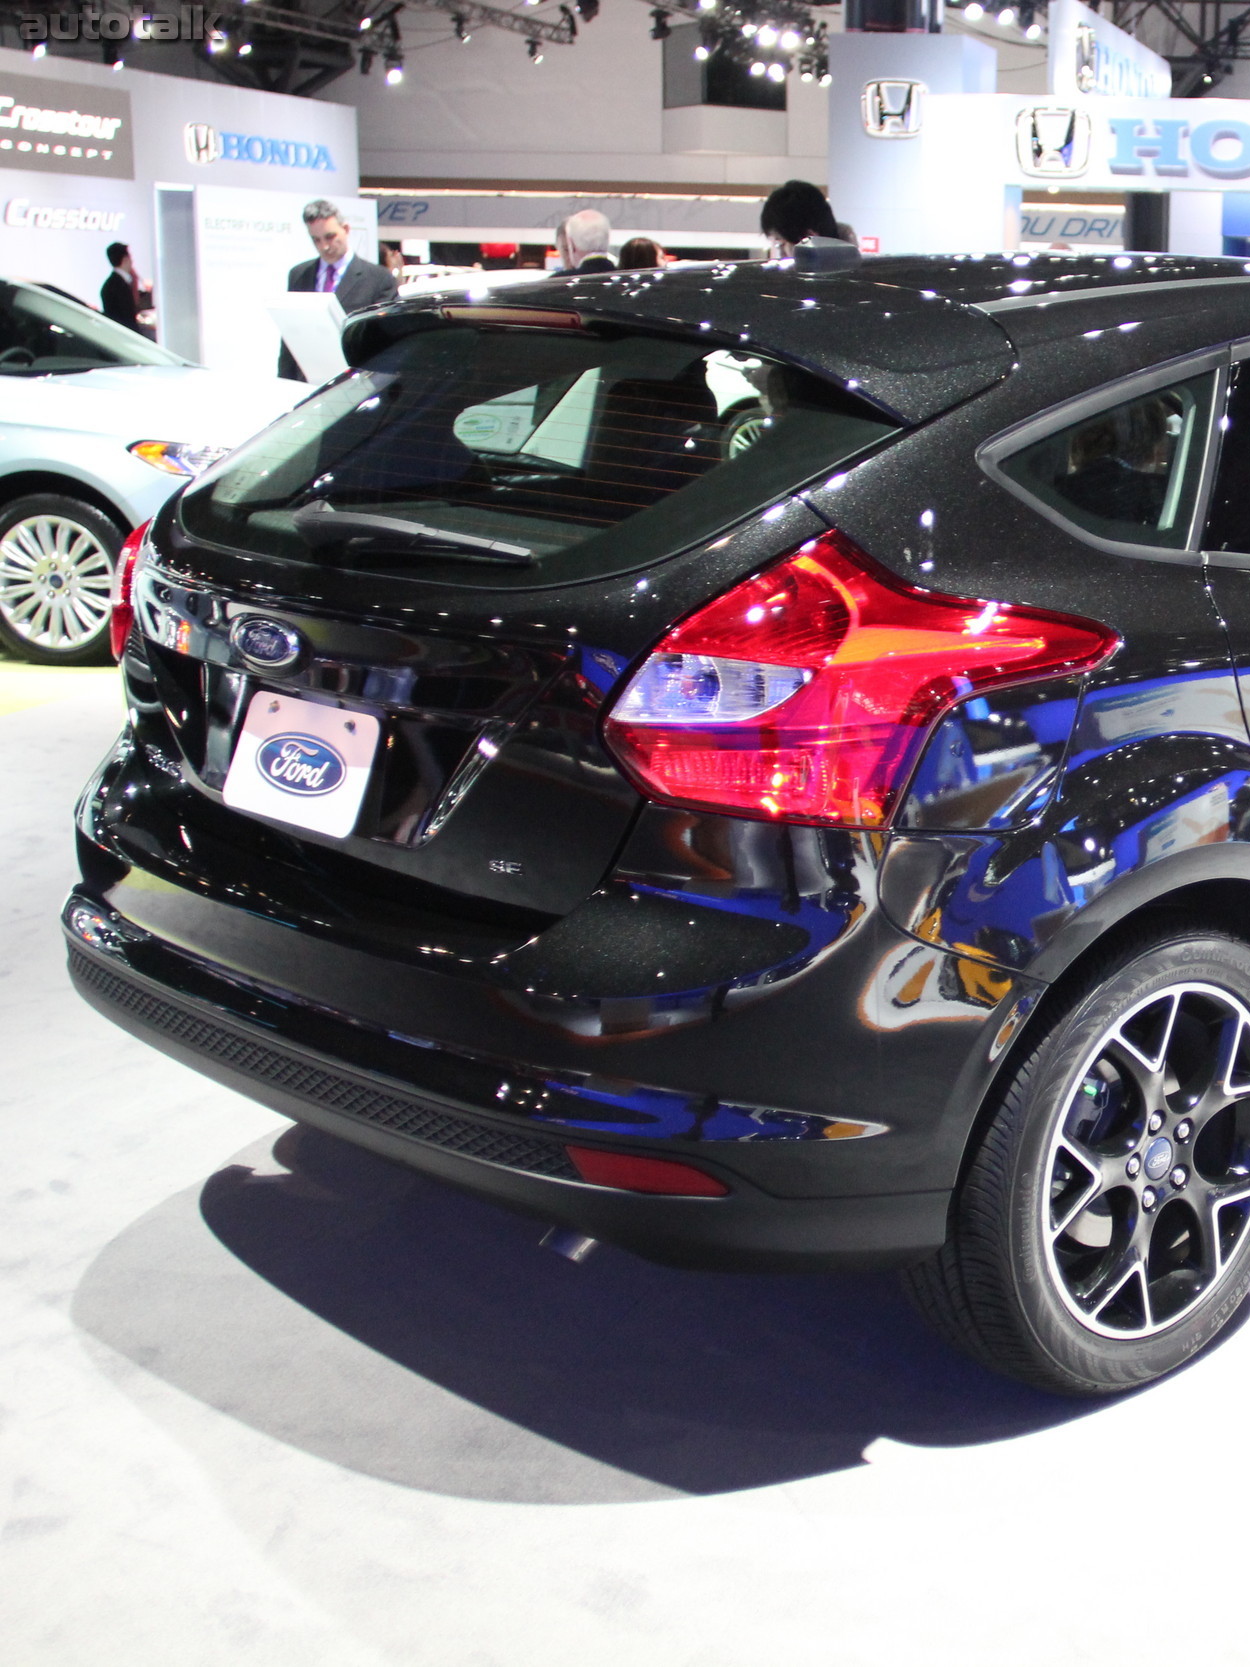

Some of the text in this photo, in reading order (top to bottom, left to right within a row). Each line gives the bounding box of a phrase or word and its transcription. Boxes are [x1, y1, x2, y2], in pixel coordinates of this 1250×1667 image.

[219, 132, 337, 172] HONDA
[5, 198, 126, 232] Crosstour
[1060, 217, 1125, 238] DRI
[246, 626, 281, 657] Ford
[270, 740, 331, 788] Ford
